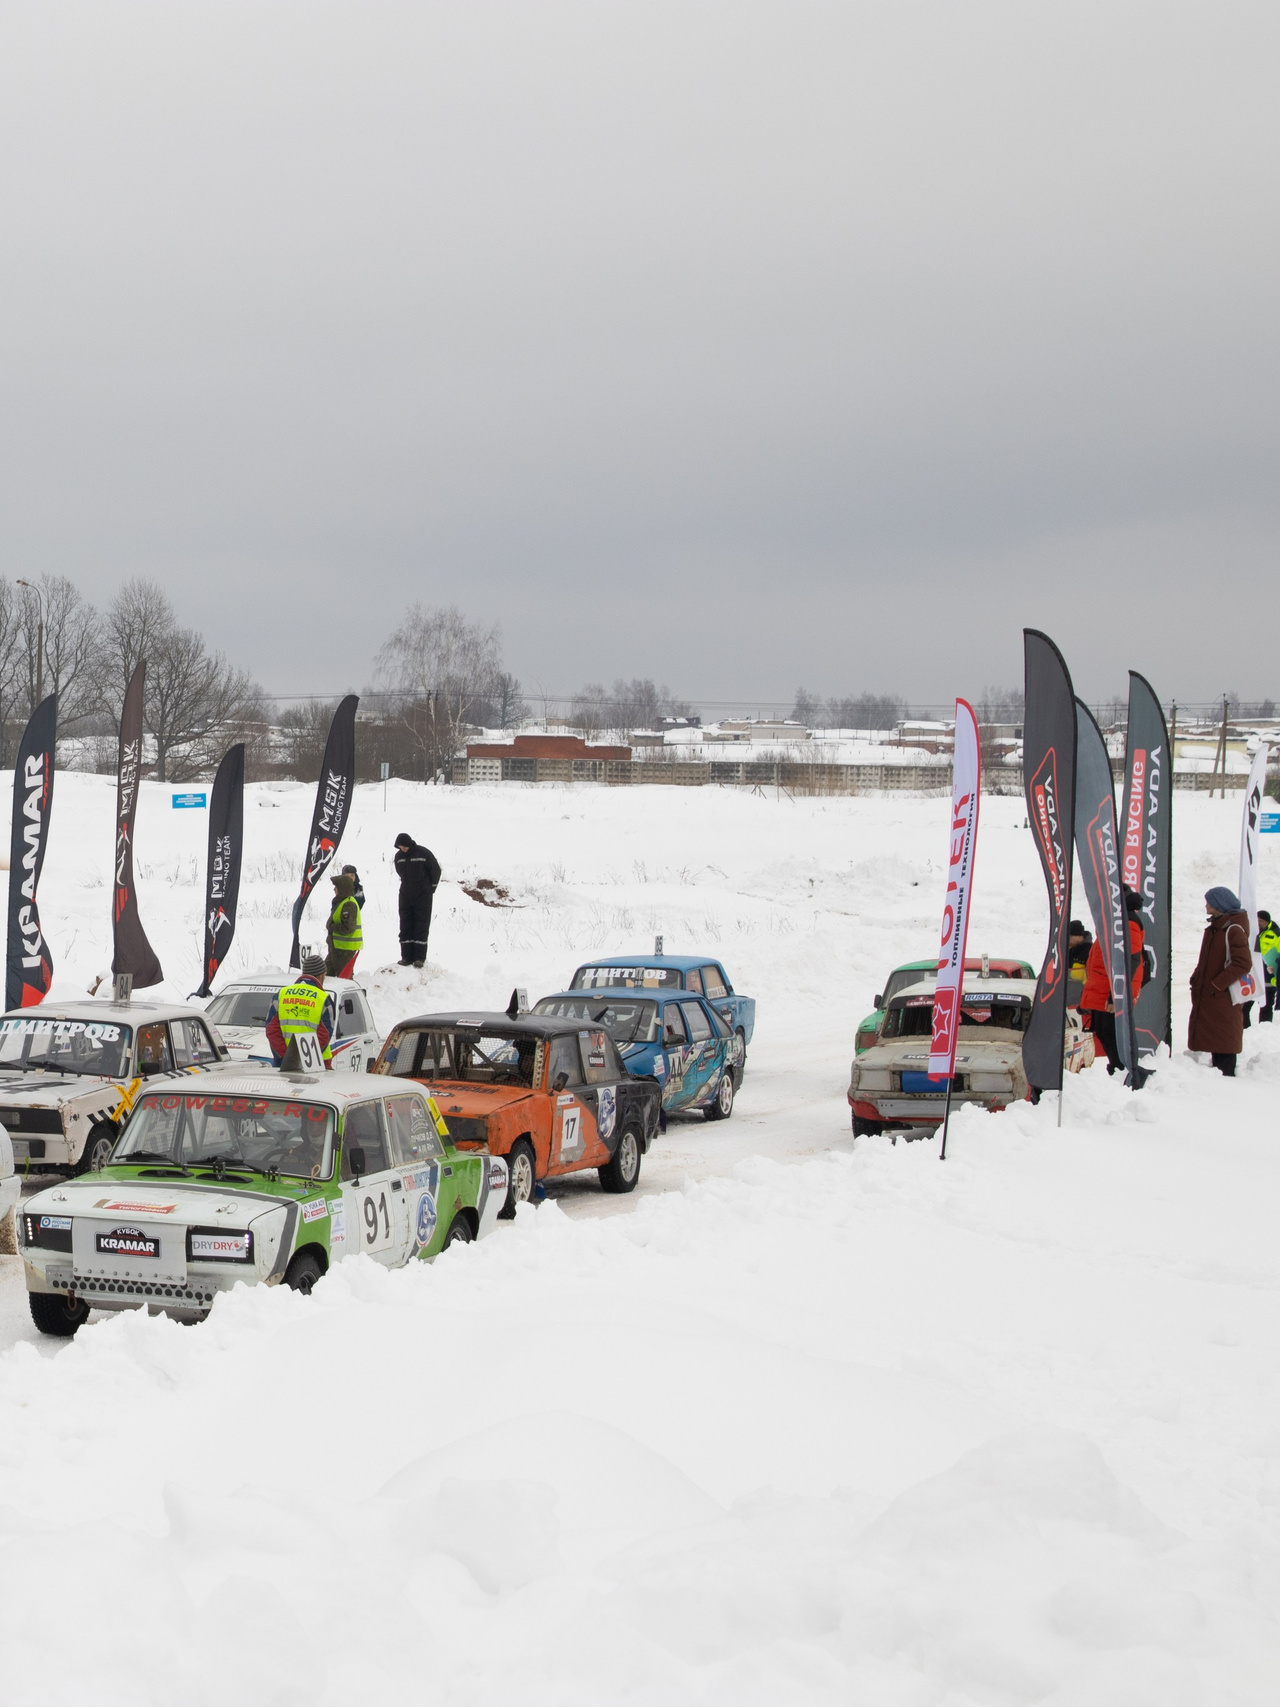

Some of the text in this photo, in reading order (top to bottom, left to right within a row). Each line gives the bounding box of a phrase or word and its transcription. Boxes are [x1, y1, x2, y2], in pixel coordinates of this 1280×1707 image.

[120, 740, 135, 817] MSK
[318, 769, 342, 832] MSK
[331, 776, 347, 834] RACING TEAM
[223, 836, 231, 860] TEAM
[951, 886, 964, 968] ТОПЛИВНЫЕ
[582, 968, 667, 980] ДМИТОВ
[119, 975, 129, 999] 84
[248, 985, 281, 993] Ивант
[285, 987, 318, 999] RUSTA
[282, 997, 316, 1008] МАРШАЛ
[191, 1022, 202, 1048] 84
[299, 1036, 323, 1069] 91
[671, 1056, 683, 1082] 44
[142, 1095, 328, 1123] ROWE62.RU
[565, 1117, 577, 1140] 17
[364, 1192, 390, 1245] 91
[117, 1228, 140, 1236] КУБОК
[100, 1238, 155, 1253] KRAMAR
